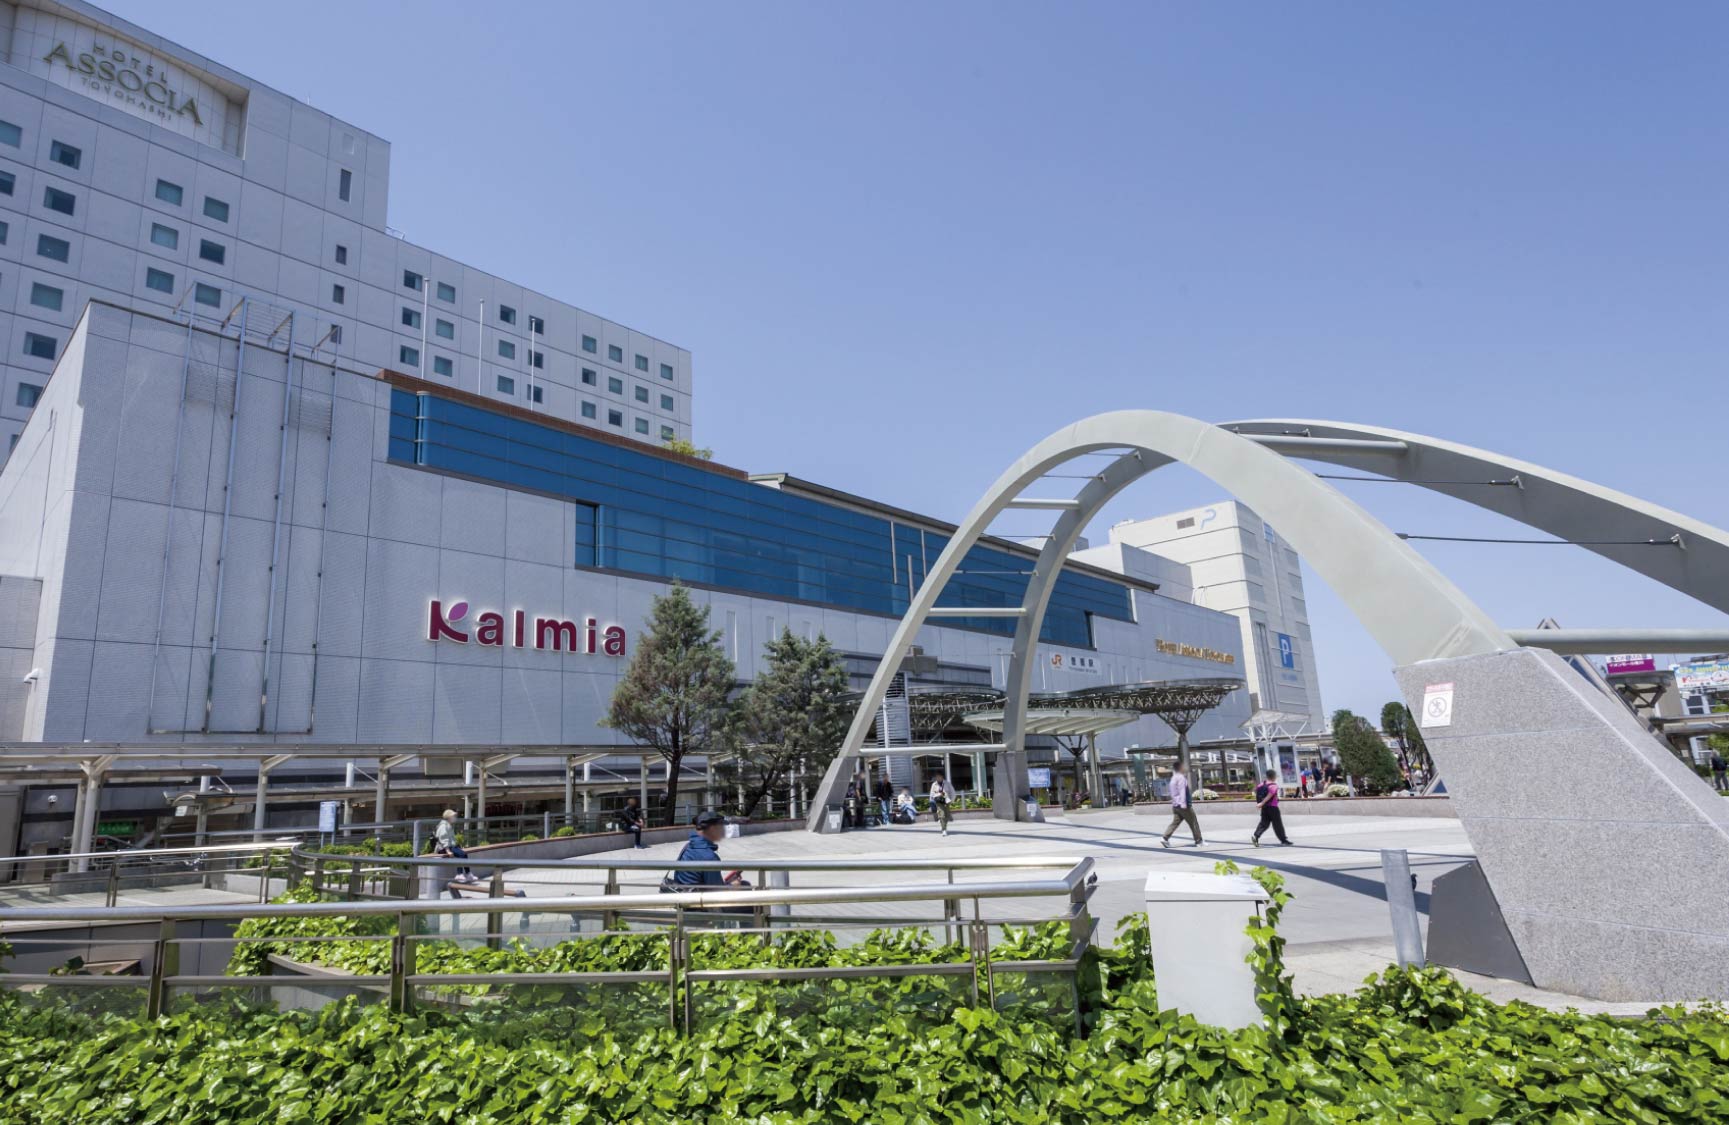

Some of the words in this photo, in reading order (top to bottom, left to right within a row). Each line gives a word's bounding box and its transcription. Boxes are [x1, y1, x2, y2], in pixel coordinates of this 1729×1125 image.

[43, 41, 203, 125] ASSOCIA
[93, 43, 168, 84] HOTEL
[427, 600, 626, 656] Kalmia
[1051, 654, 1063, 666] JR
[1280, 638, 1290, 665] P
